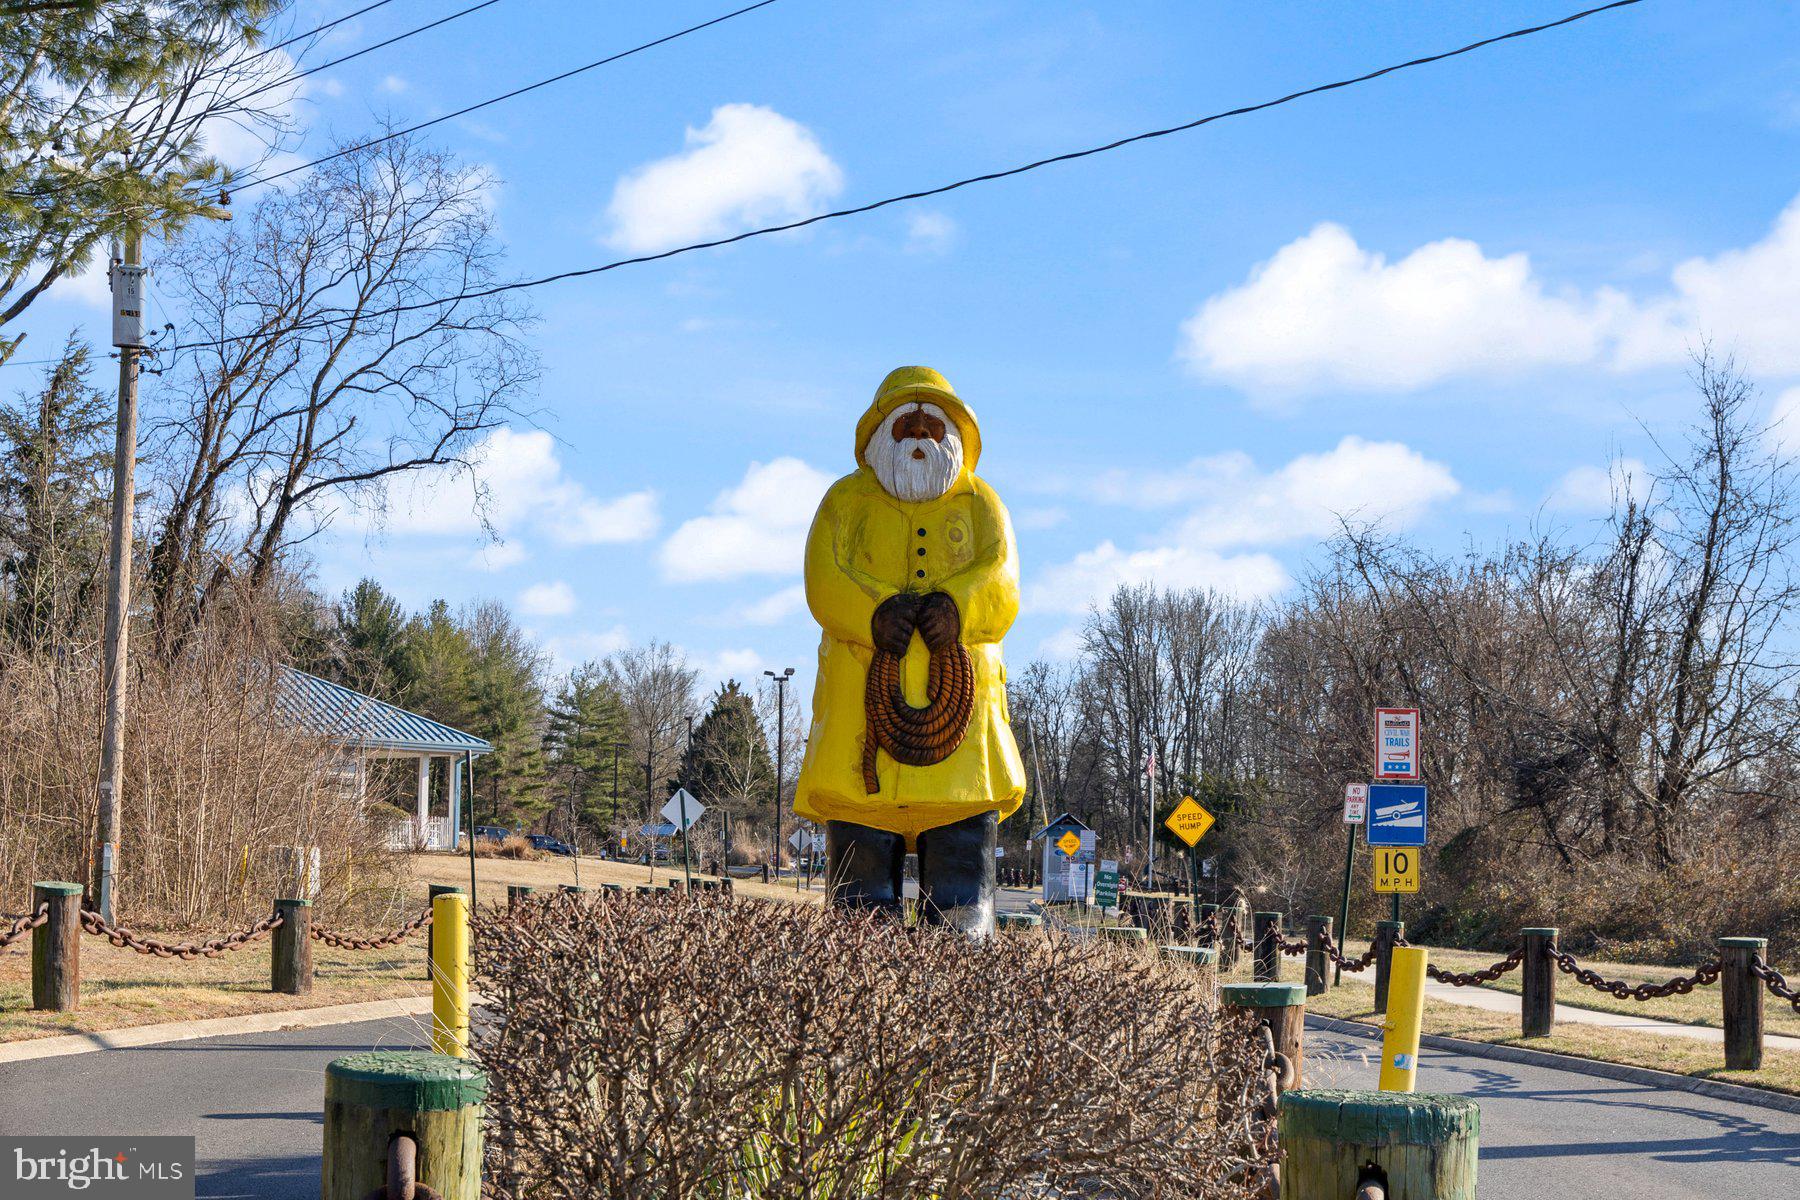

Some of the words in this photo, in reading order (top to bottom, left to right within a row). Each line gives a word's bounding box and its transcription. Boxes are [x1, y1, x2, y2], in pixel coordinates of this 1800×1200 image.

[1385, 738, 1410, 747] TRAILS
[1352, 787, 1361, 795] NO
[1177, 813, 1202, 821] SPEED
[1179, 822, 1202, 830] HUMP
[1385, 852, 1408, 874] 10
[1096, 890, 1116, 898] Parking
